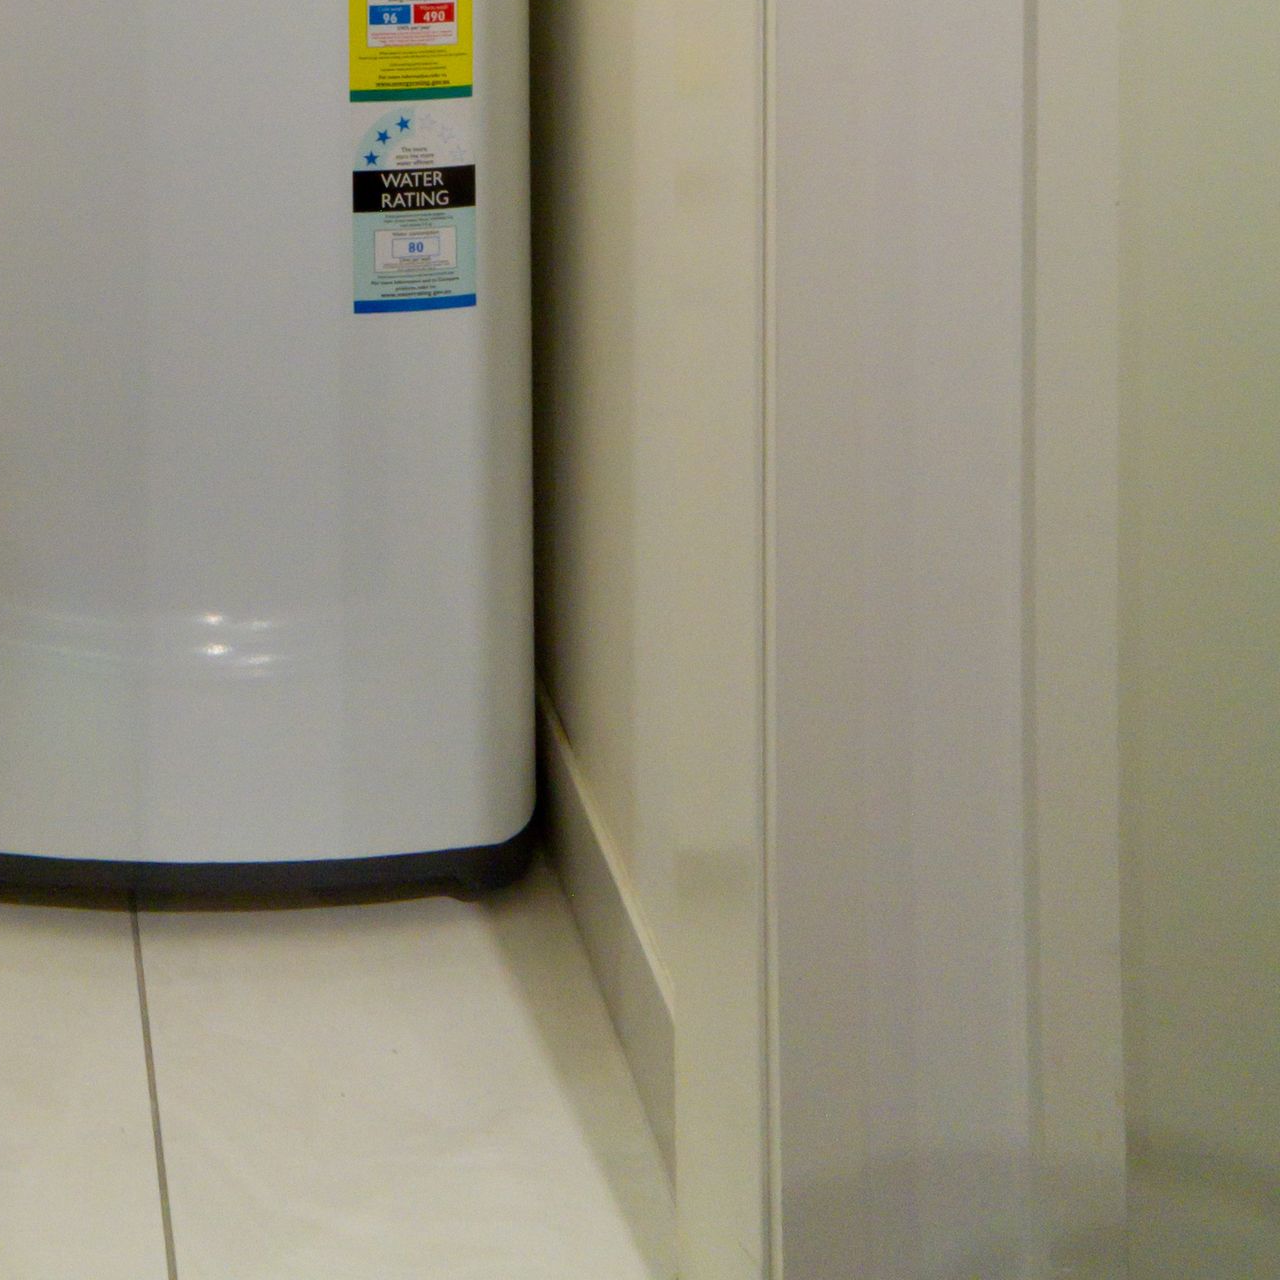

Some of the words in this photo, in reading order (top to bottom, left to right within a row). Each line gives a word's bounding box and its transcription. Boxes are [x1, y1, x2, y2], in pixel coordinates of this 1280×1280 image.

[383, 12, 398, 24] 96
[423, 11, 446, 23] 490
[380, 171, 444, 189] WATER
[381, 190, 449, 209] RATING
[408, 241, 424, 253] 80
